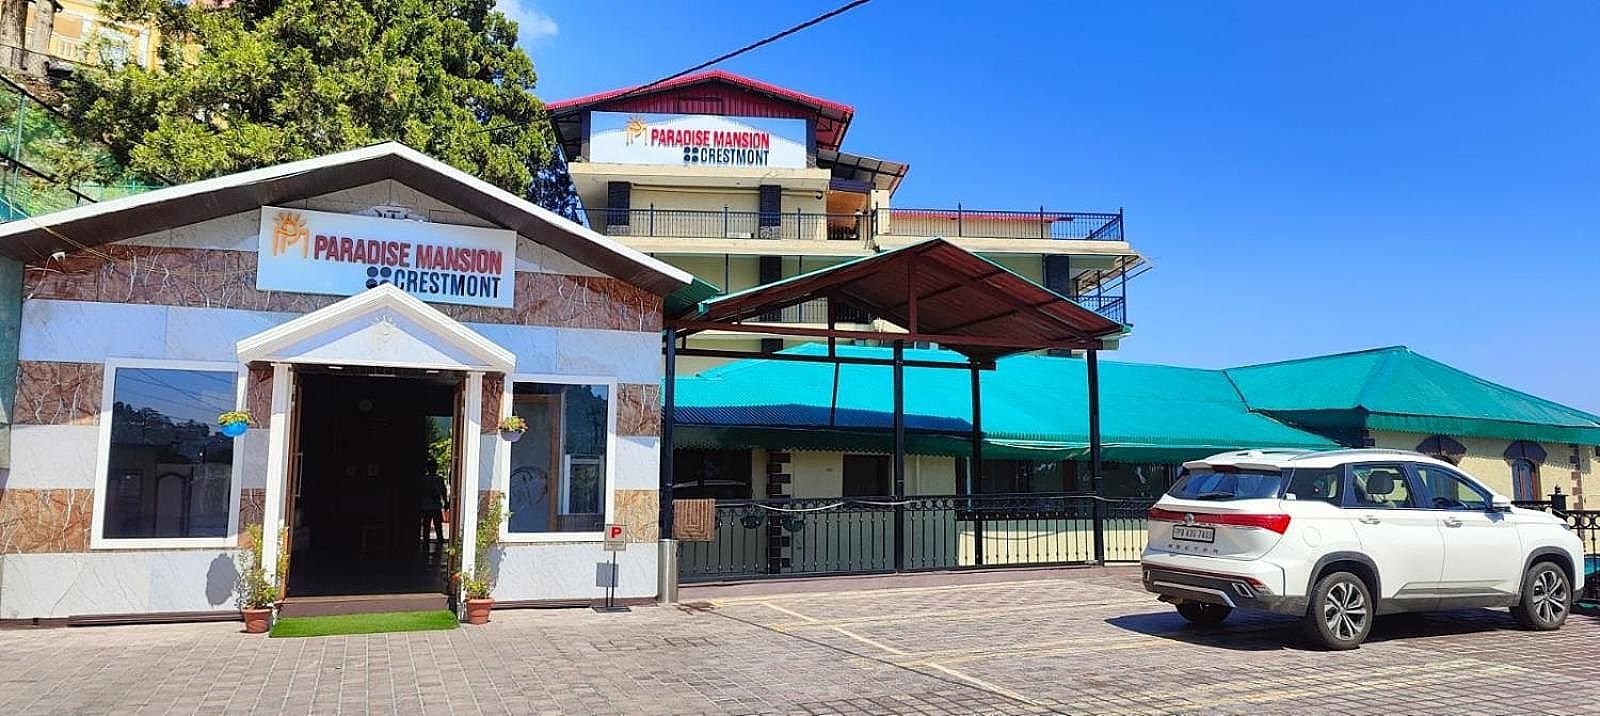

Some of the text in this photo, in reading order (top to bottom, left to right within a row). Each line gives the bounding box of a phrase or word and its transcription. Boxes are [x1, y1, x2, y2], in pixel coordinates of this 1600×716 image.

[651, 128, 710, 147] PARADISE
[714, 131, 770, 149] MANSION
[700, 148, 769, 166] CRESTMONT
[314, 235, 411, 268] PARADISE
[416, 244, 502, 274] MANSION
[394, 269, 501, 298] CRESTMONT
[611, 527, 622, 538] P
